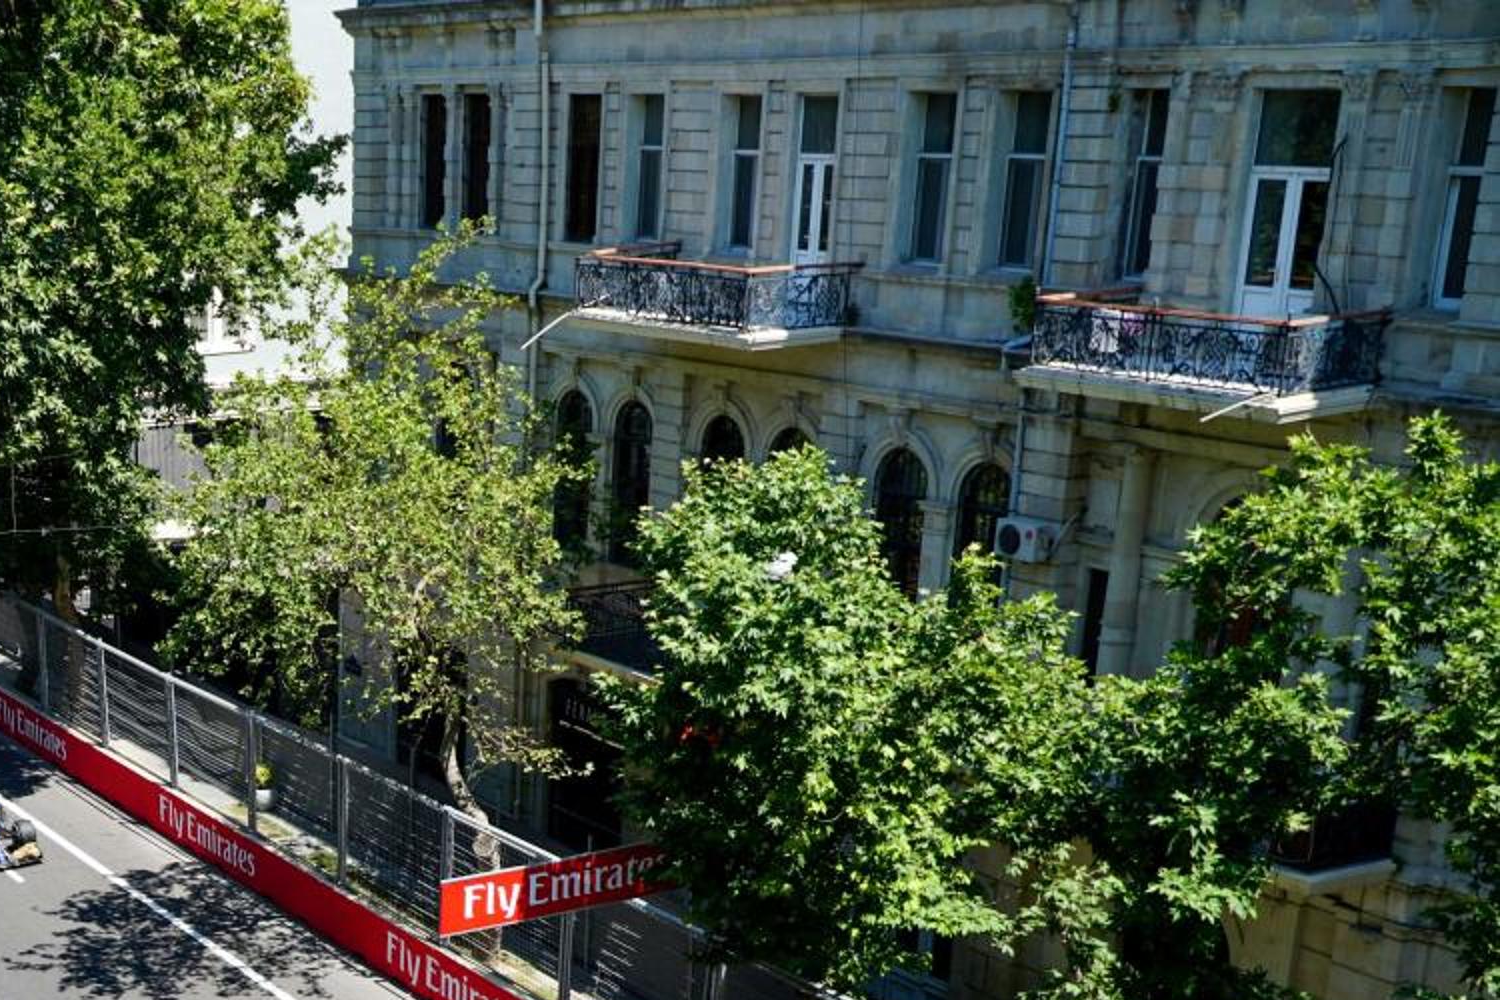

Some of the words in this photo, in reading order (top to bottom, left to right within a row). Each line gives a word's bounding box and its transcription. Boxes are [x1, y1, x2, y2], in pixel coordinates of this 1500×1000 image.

[17, 710, 67, 761] Emirates
[159, 794, 183, 839] Fly
[187, 811, 256, 877] Emirates
[462, 881, 521, 919] Fly
[386, 931, 421, 985] Fly
